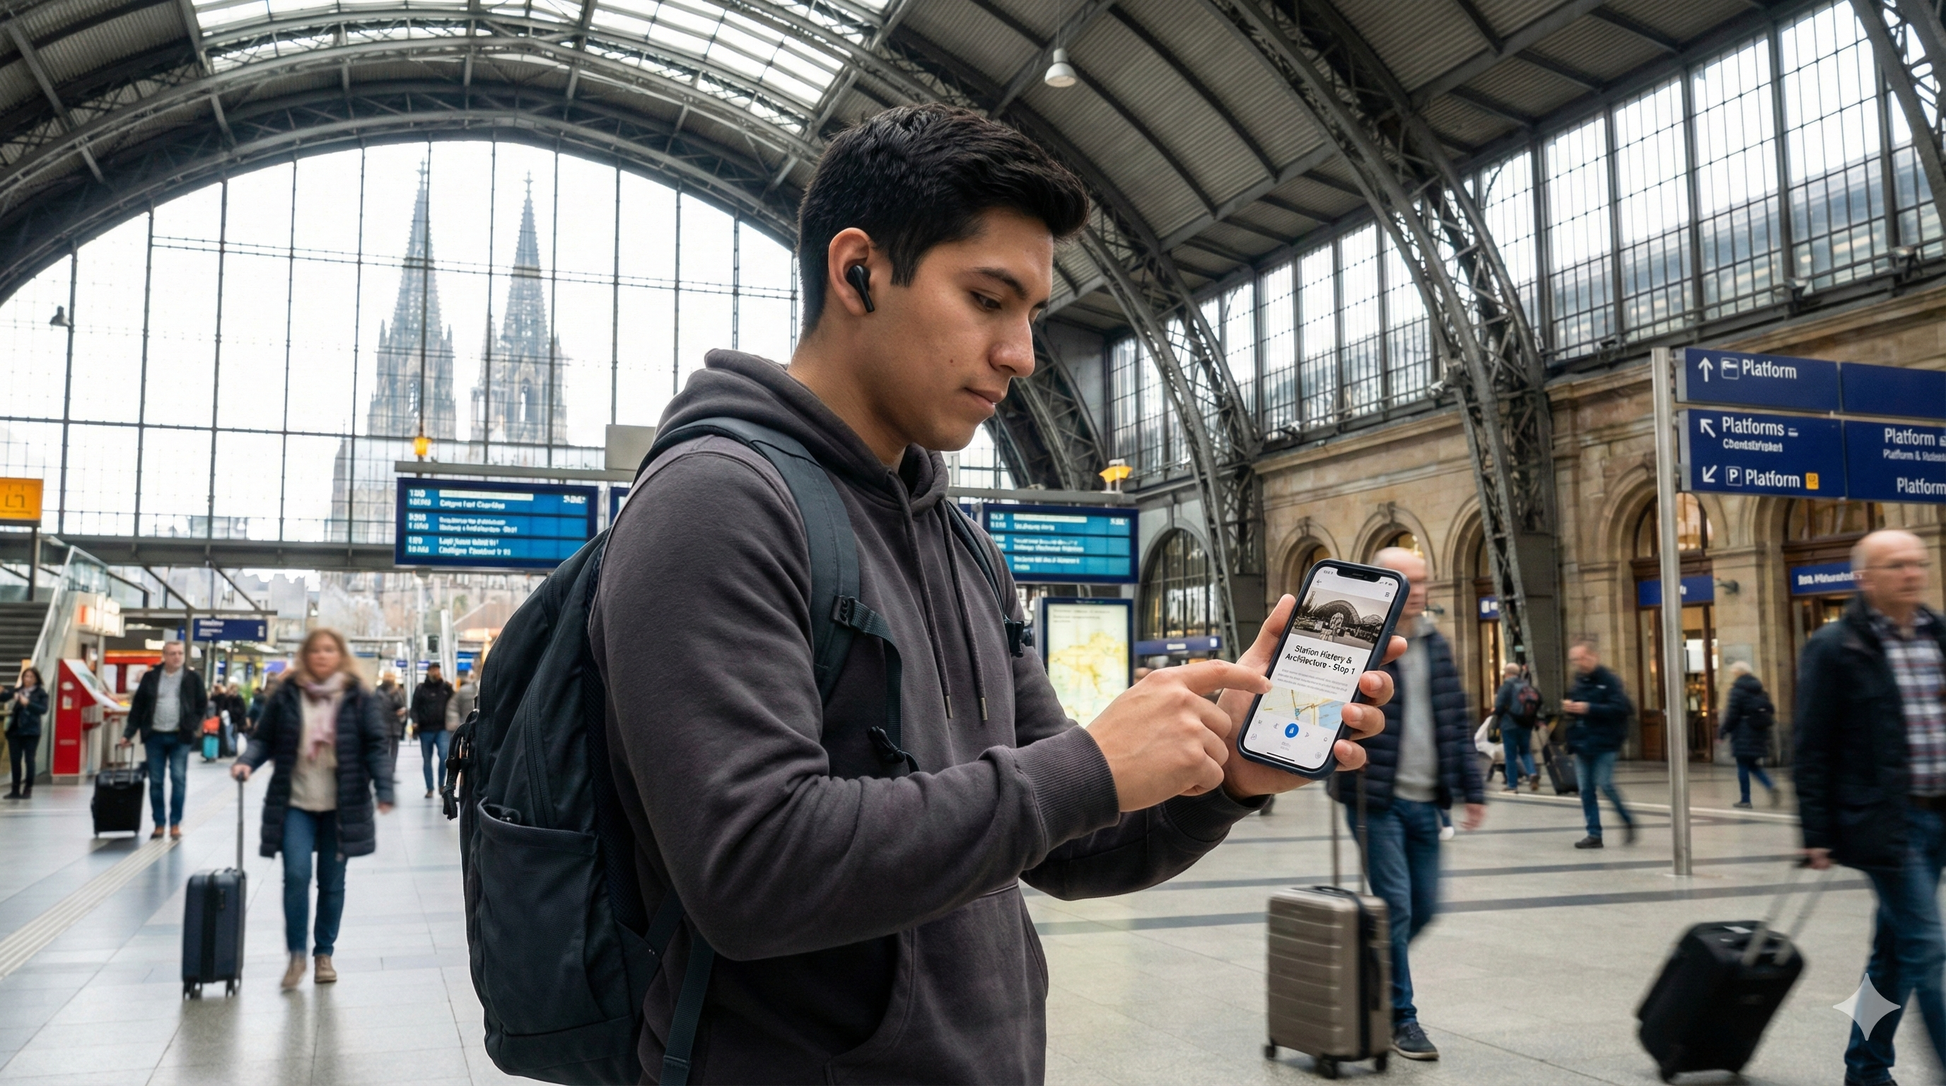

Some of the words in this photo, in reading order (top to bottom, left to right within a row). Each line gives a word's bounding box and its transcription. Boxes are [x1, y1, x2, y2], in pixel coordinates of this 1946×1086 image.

[1742, 358, 1797, 380] Platform
[1722, 416, 1785, 437] Platforms
[1884, 427, 1936, 447] Platform
[1745, 468, 1800, 488] Platform
